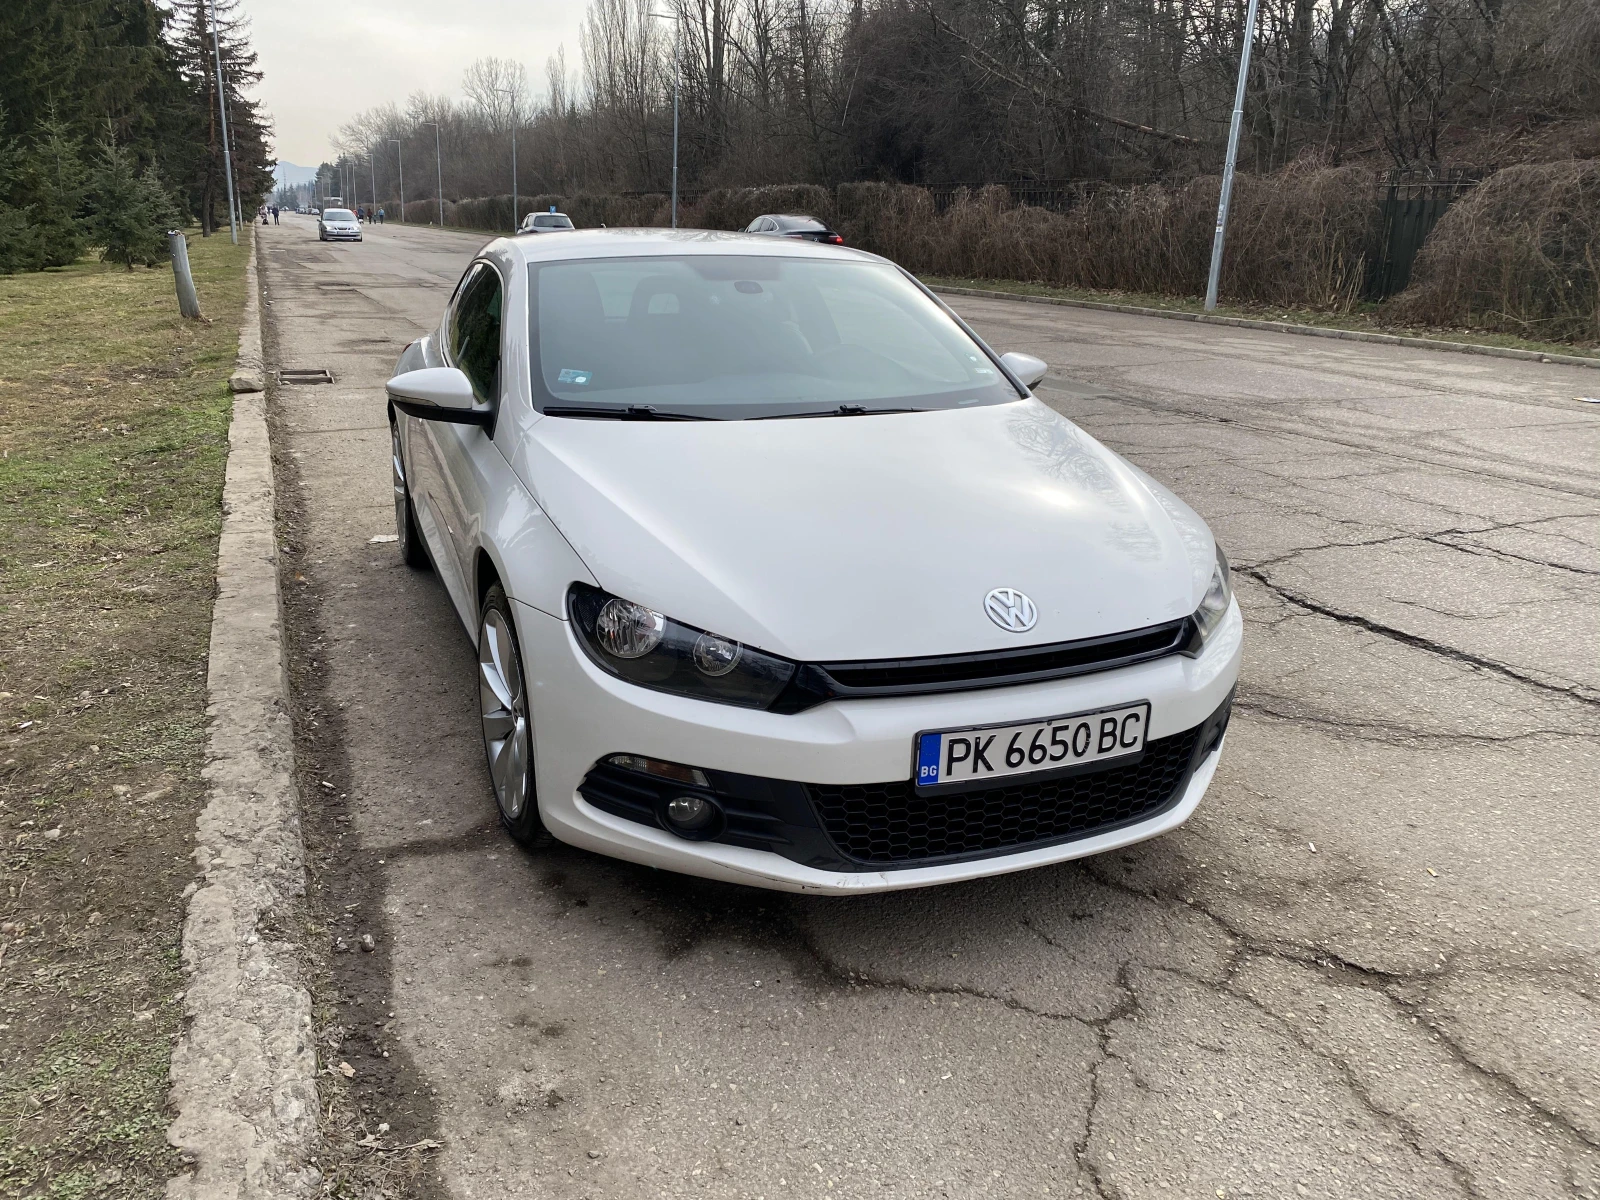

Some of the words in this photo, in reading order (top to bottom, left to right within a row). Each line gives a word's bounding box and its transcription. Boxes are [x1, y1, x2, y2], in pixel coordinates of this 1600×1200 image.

[985, 588, 1034, 630] VW
[947, 734, 996, 775] PK
[1005, 722, 1091, 768] 6650
[1097, 713, 1140, 754] BC
[920, 766, 937, 778] BG
